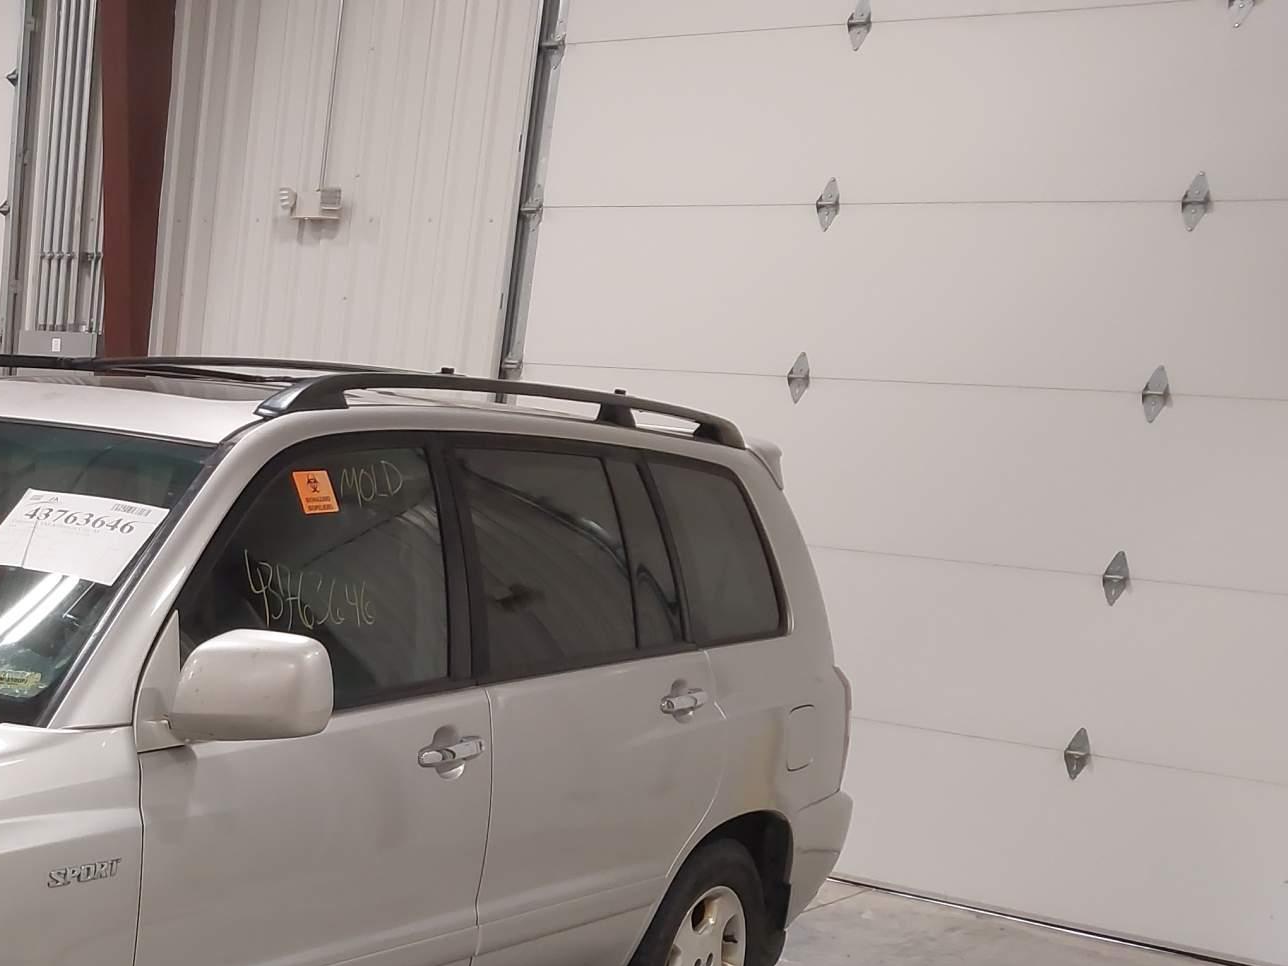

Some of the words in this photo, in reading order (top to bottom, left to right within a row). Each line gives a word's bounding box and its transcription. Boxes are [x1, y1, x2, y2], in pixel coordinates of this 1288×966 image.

[340, 460, 404, 509] MOLD
[24, 505, 139, 535] 43763646
[48, 858, 122, 888] SPORT
